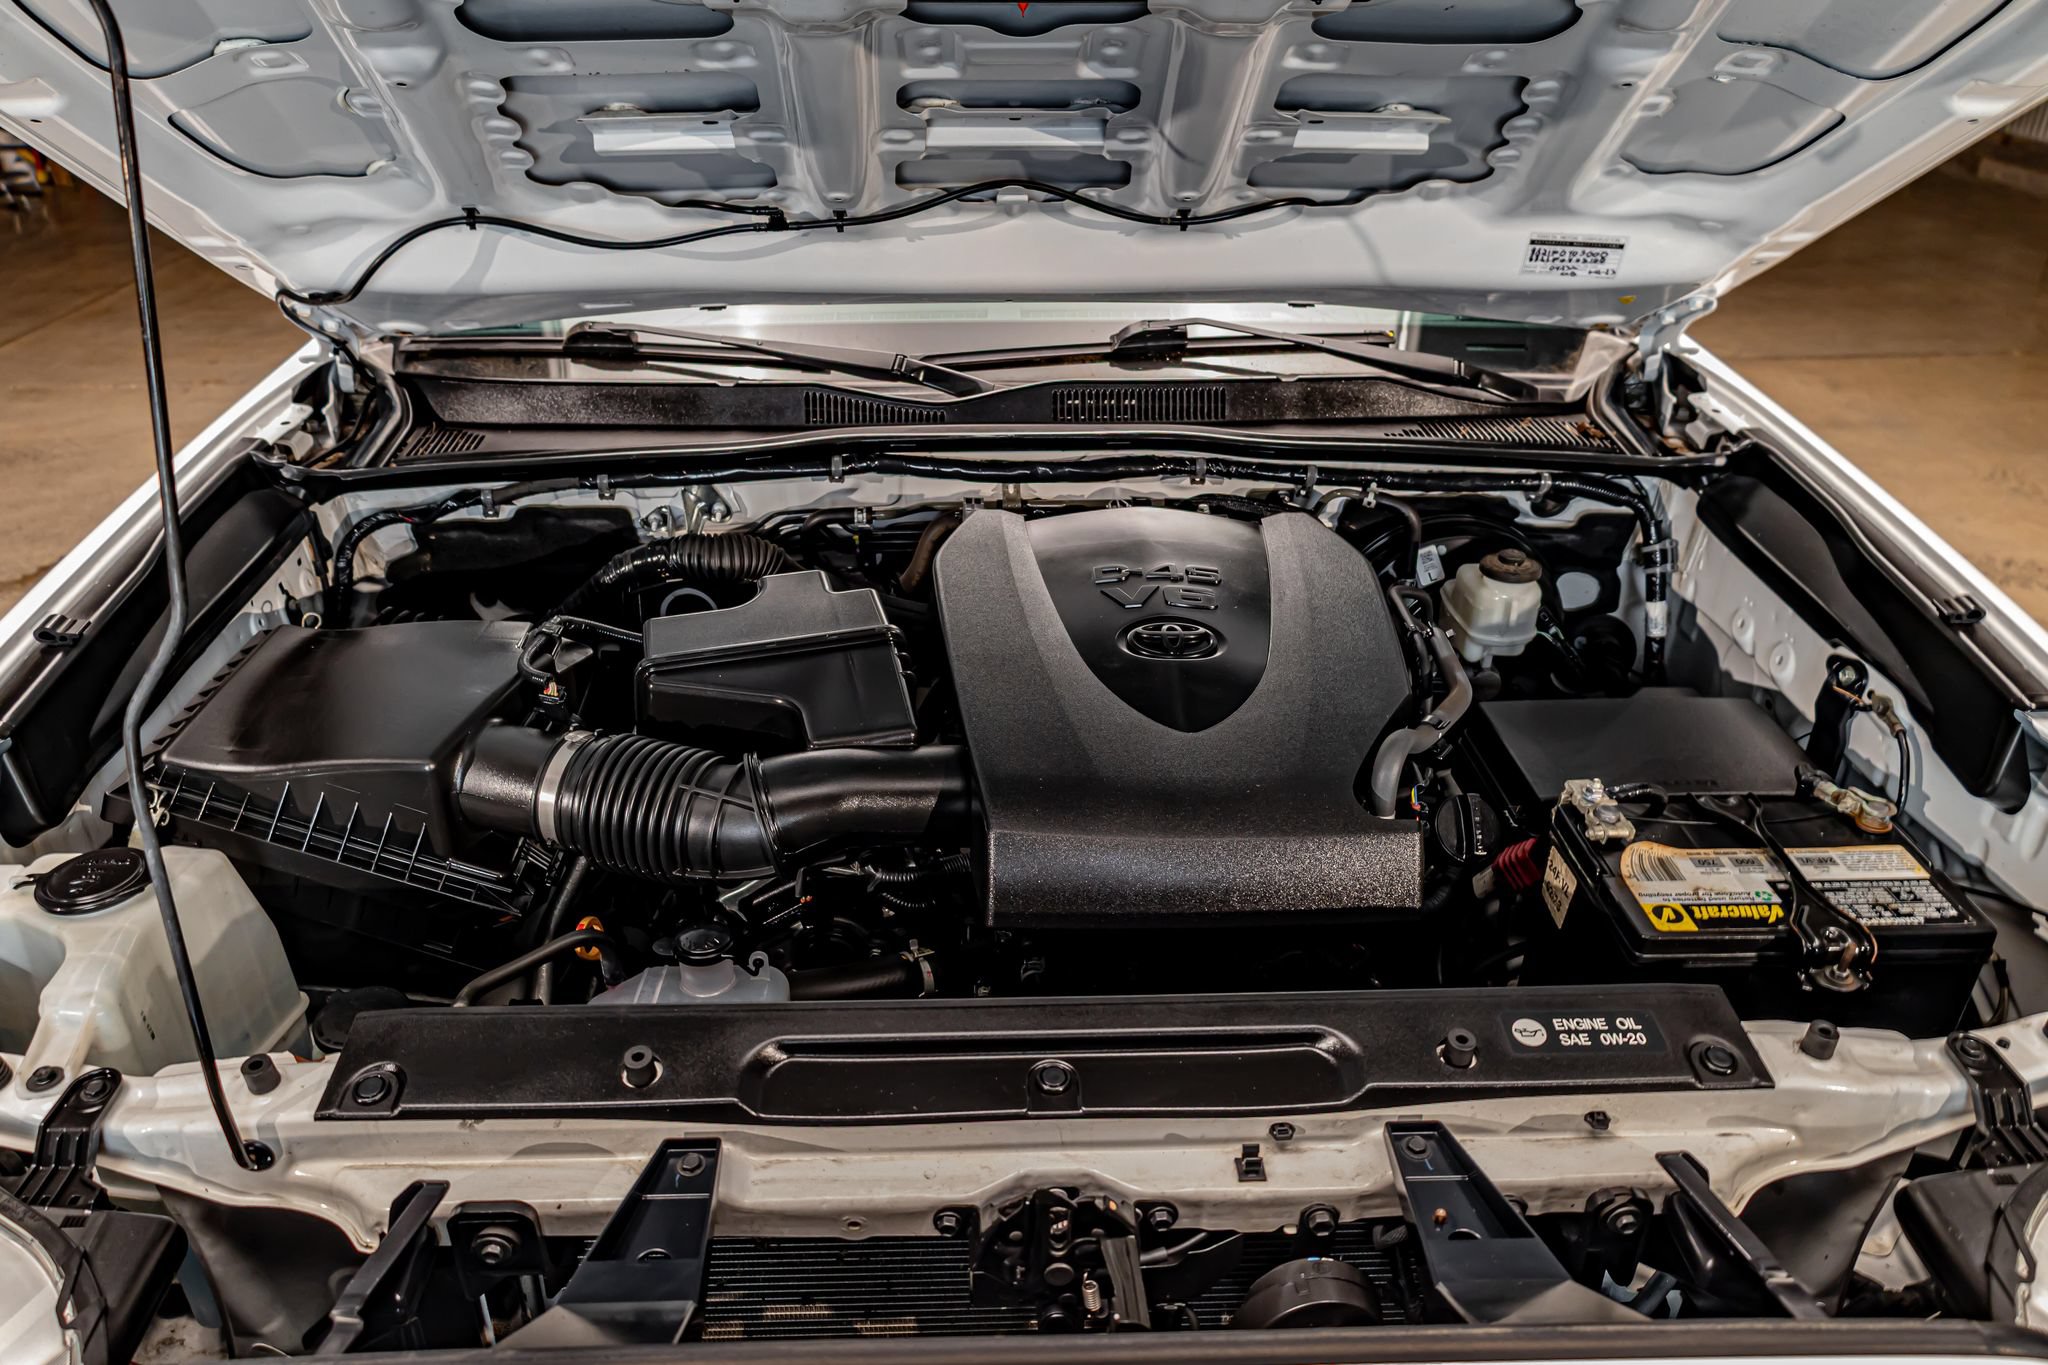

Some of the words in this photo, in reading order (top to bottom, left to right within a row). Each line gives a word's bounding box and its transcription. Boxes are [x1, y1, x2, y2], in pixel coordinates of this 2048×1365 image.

[1100, 585, 1219, 610] V6
[1691, 905, 1784, 924] Valucraft
[1552, 1018, 1609, 1031] ENGINE
[1615, 1017, 1642, 1030] OIL
[1559, 1033, 1592, 1046] SAE
[1600, 1033, 1647, 1046] 0W-20
